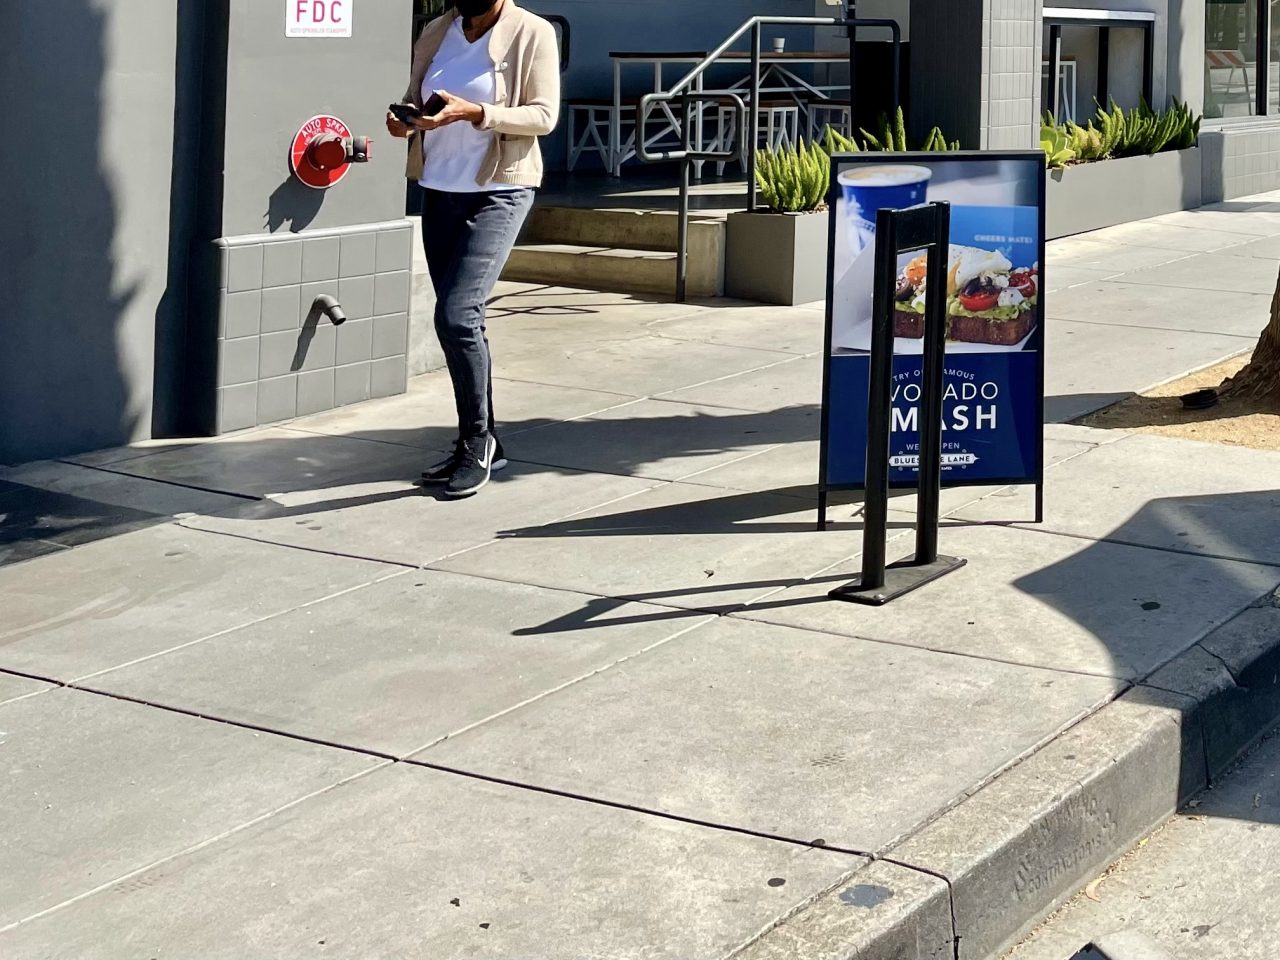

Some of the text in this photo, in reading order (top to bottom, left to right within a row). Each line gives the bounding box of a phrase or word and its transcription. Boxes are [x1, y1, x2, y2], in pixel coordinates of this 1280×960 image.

[296, 0, 343, 23] FDC
[301, 119, 322, 138] AUTO
[943, 368, 975, 380] AMOUS
[891, 381, 999, 402] VOADO
[947, 454, 971, 462] LANE
